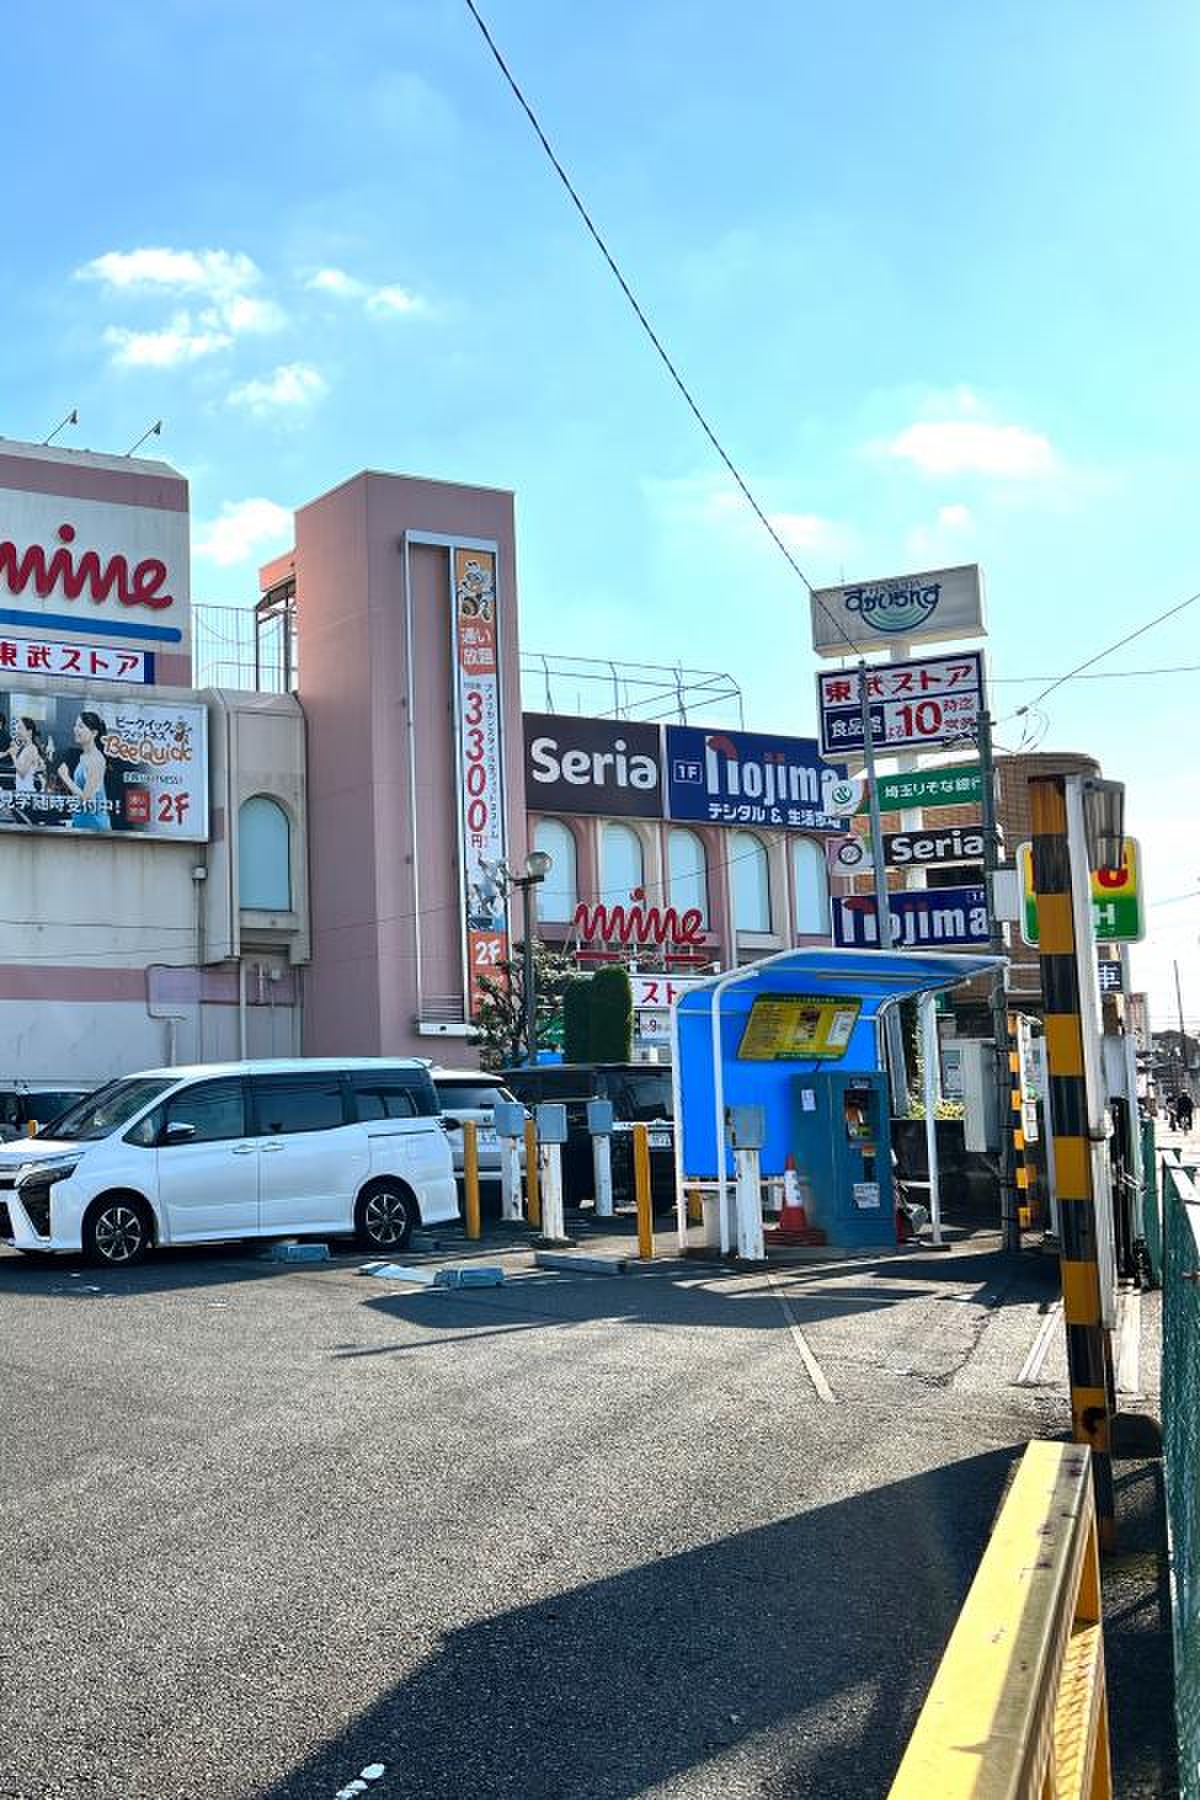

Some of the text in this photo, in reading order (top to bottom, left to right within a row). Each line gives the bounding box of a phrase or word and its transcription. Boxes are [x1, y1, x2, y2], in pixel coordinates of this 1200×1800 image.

[531, 738, 657, 790] Seria
[678, 764, 697, 780] 1F
[158, 792, 189, 825] 2F
[708, 803, 765, 822] デジタル
[891, 830, 985, 862] Seria
[574, 887, 706, 945] mine
